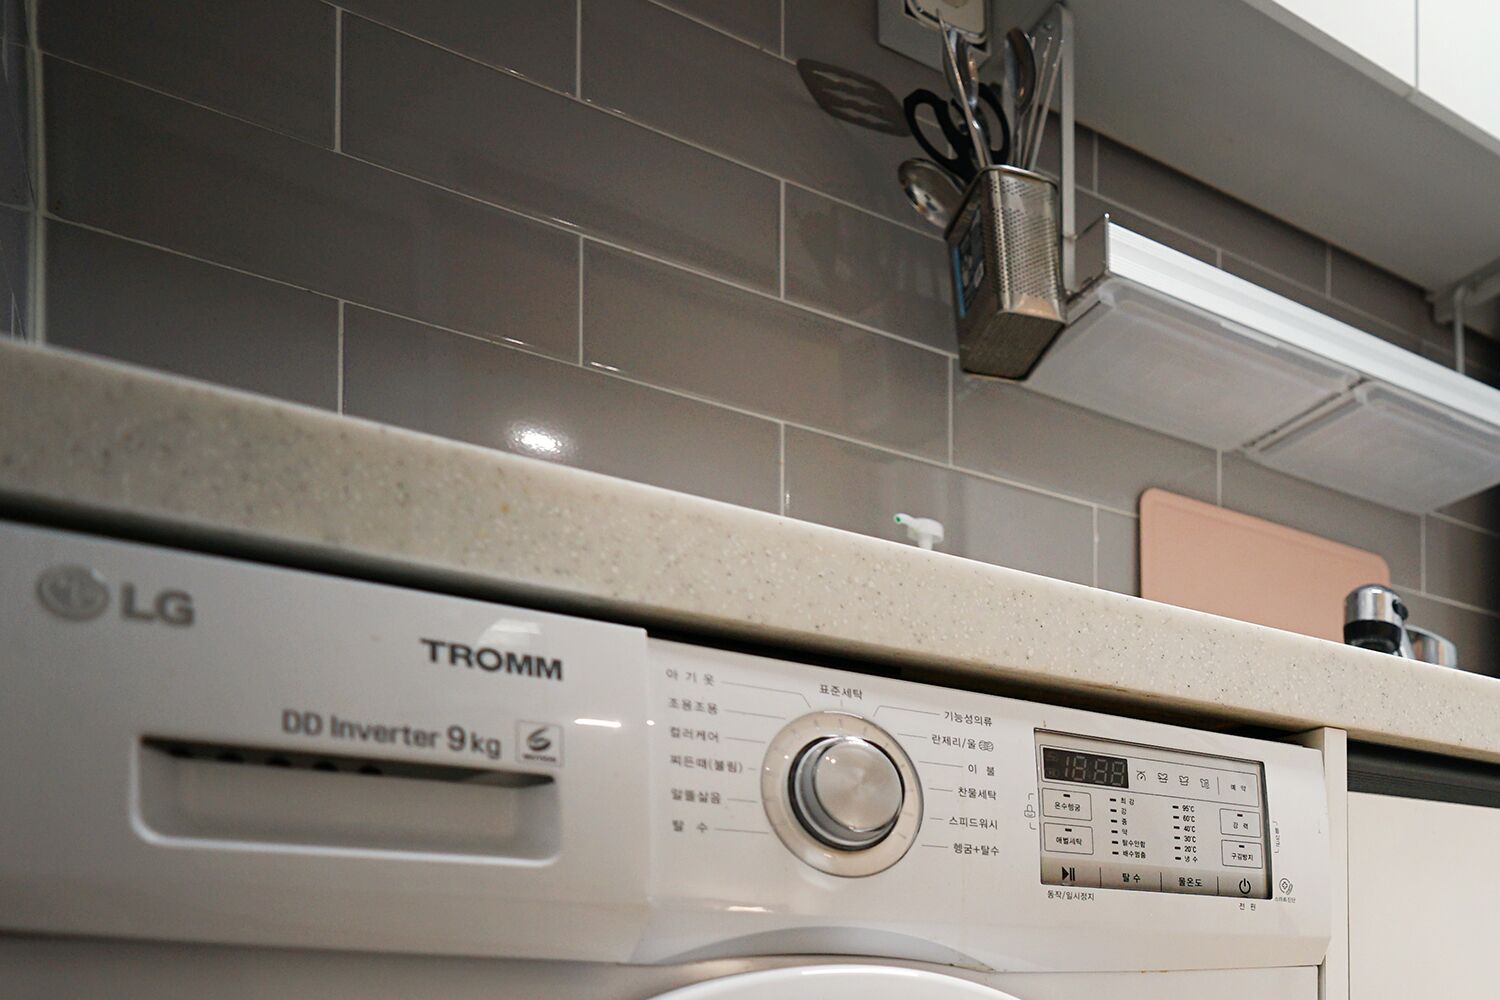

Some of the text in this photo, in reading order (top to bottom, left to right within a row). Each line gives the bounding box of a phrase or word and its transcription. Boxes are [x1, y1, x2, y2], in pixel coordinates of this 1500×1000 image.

[120, 582, 195, 627] LG
[420, 638, 563, 681] TROMM
[819, 684, 863, 700] 표준세탁
[944, 711, 993, 727] 기능성의류
[281, 709, 323, 735] DD
[330, 715, 439, 748] Inverter
[669, 726, 719, 743] 컬러케어
[931, 734, 976, 750] 란제리/울
[958, 786, 997, 800] 찬물세탁
[949, 816, 998, 830] 스피드워시
[953, 842, 1000, 857] 헹굼+탈수
[1047, 889, 1095, 901] 동작/일시정지
